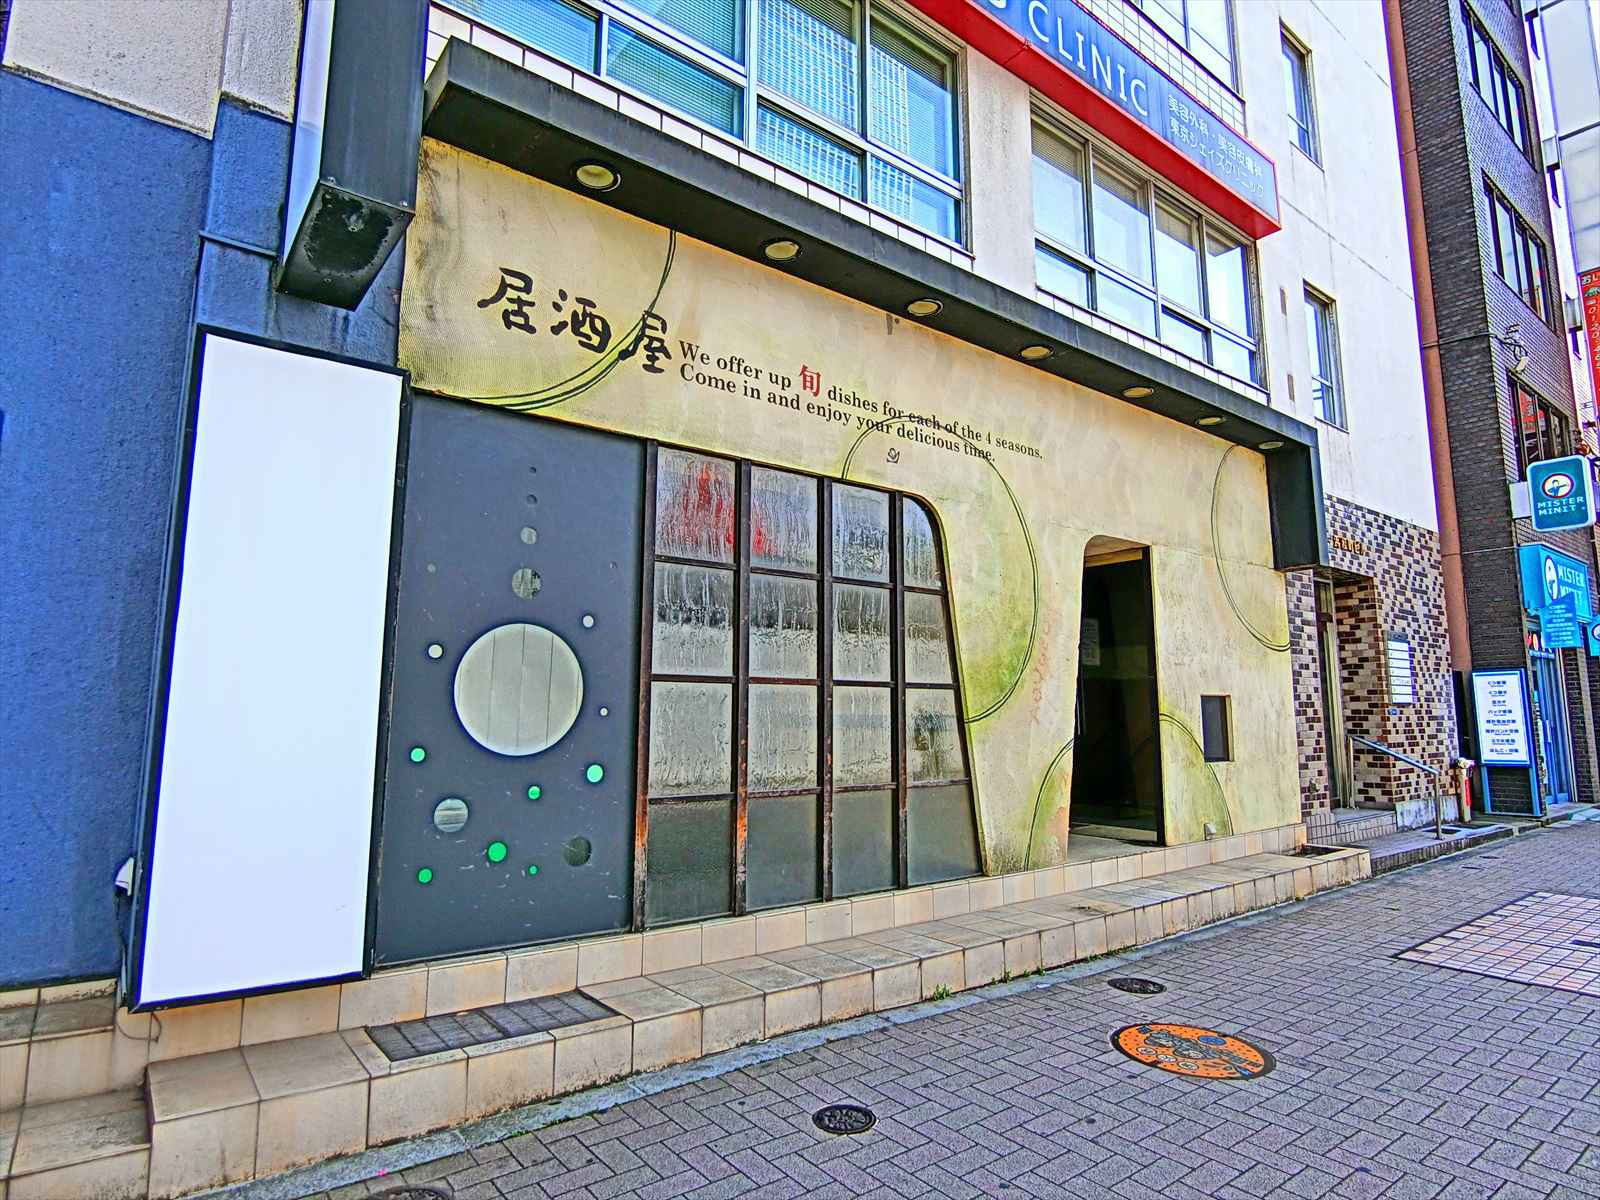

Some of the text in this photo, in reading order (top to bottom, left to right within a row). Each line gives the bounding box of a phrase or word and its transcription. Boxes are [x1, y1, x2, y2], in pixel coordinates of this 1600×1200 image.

[1028, 0, 1148, 117] CLINIC
[477, 267, 672, 374] 居酒屋
[679, 340, 1043, 460] We offer up 旬 dishes for each of the 4 seasons.
[680, 363, 995, 462] Come in and enjoy your delicious time.
[1537, 496, 1585, 509] MISTER
[1538, 504, 1577, 516] MINIT
[1557, 563, 1585, 588] MISTER
[1560, 584, 1582, 605] MIIT
